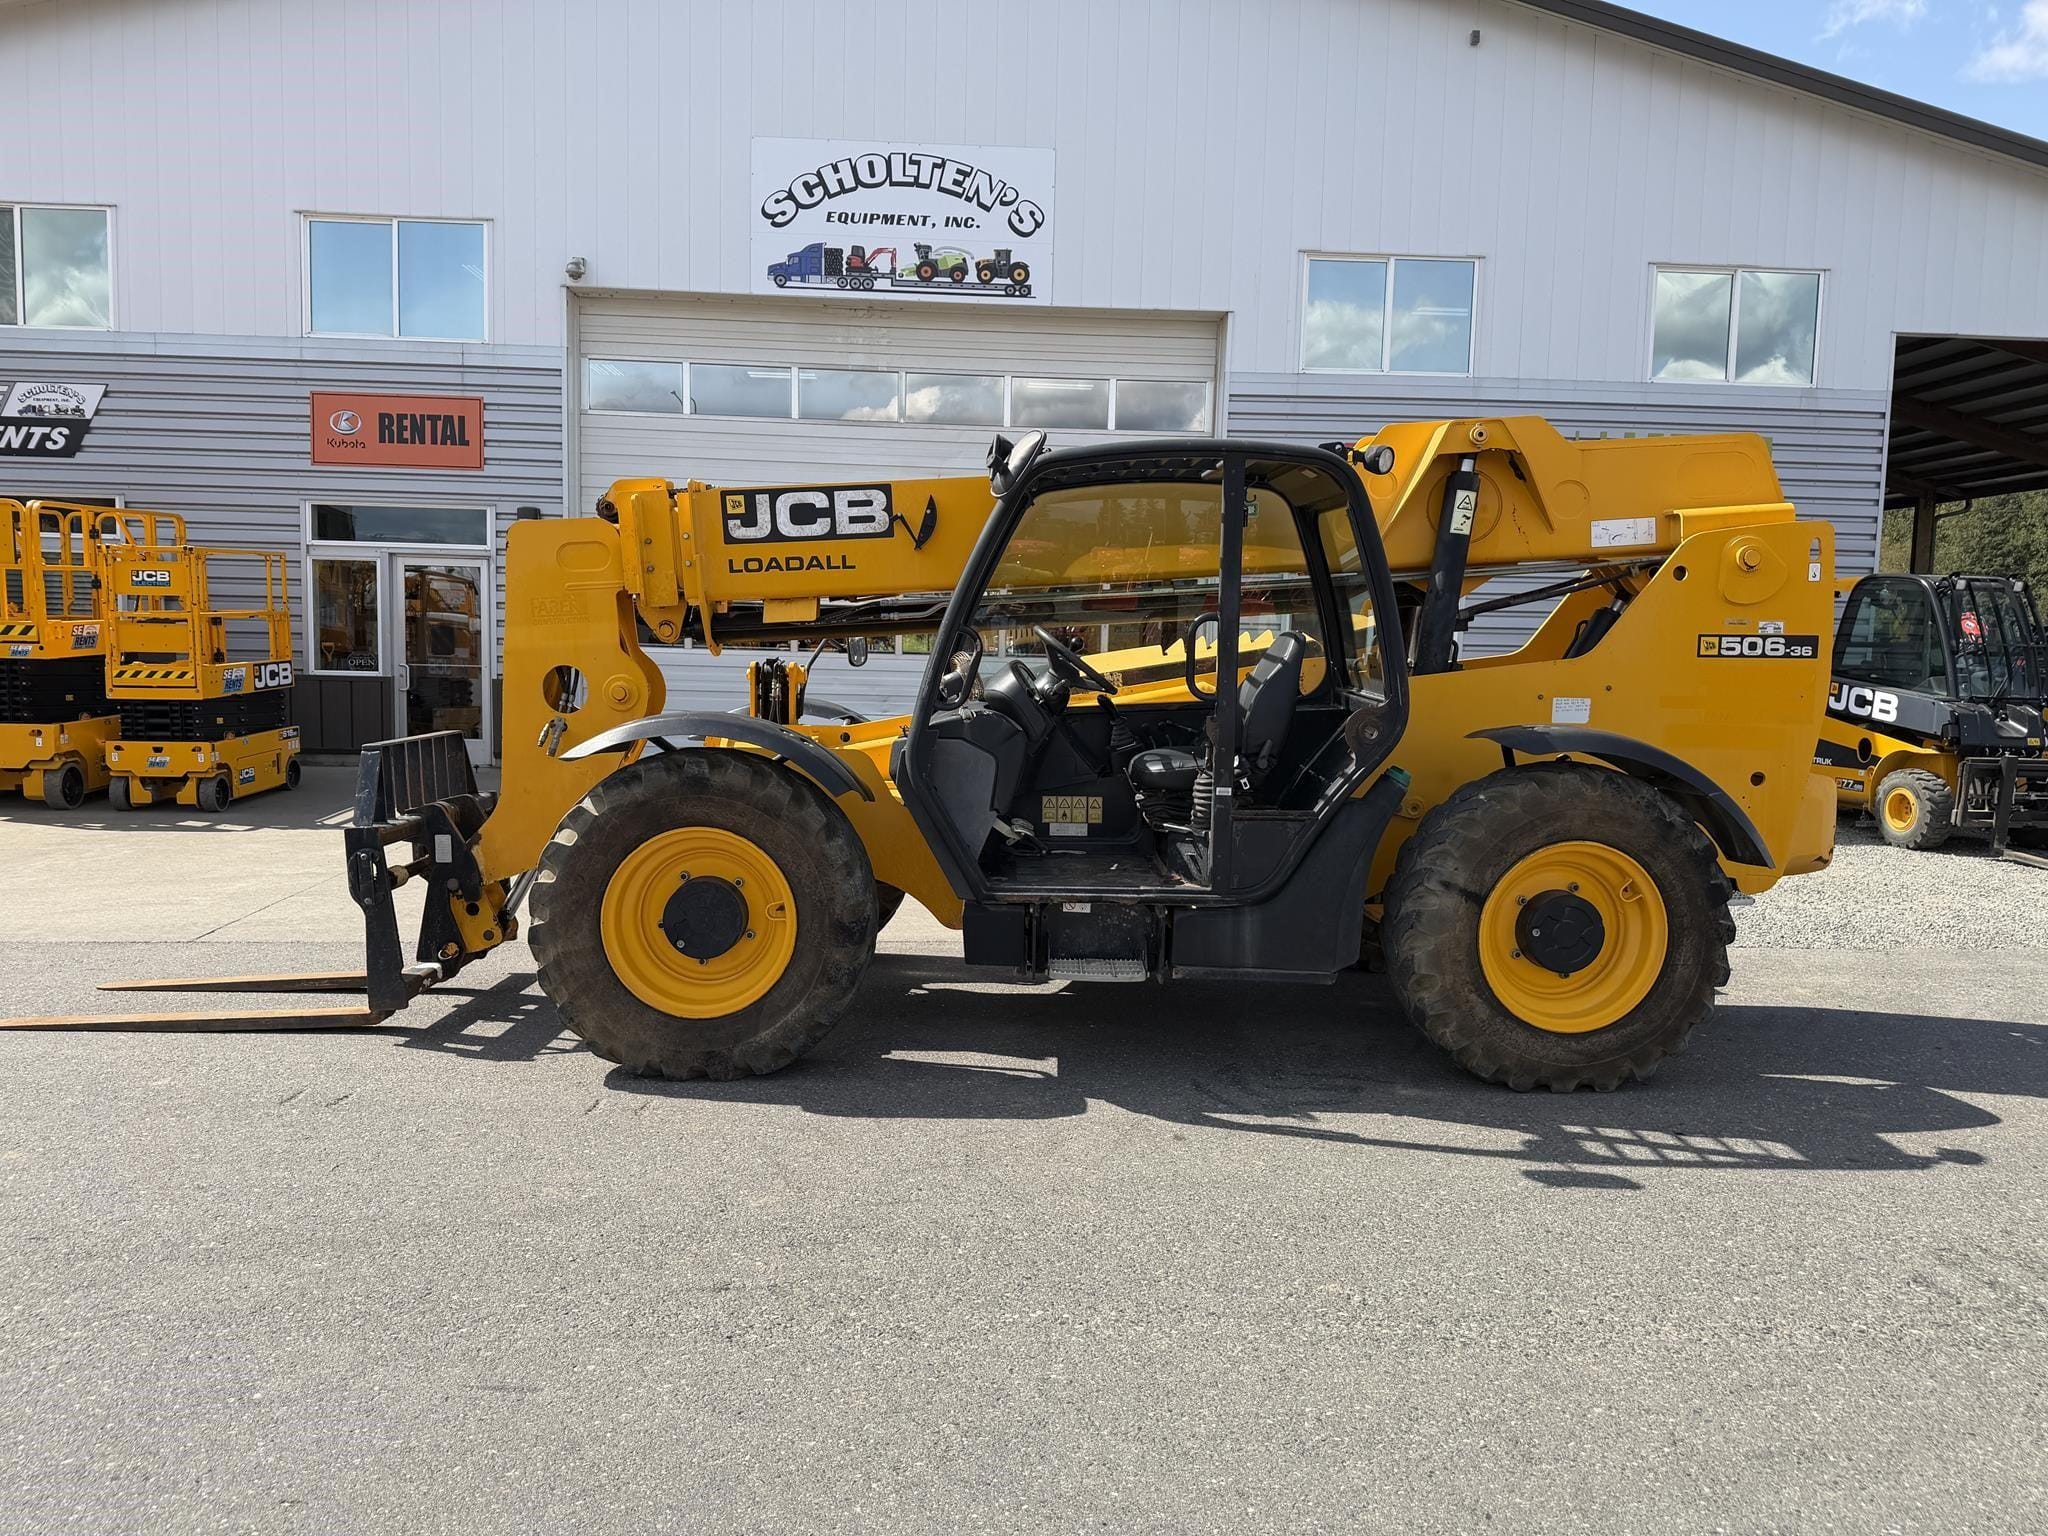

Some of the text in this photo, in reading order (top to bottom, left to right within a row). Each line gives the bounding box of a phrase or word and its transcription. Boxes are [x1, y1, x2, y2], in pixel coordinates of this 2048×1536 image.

[760, 152, 1045, 238] SCHOLTEN'S
[825, 211, 981, 229] EQUIPMENT, INC.
[0, 425, 70, 450] NTS
[378, 412, 470, 447] RENTAL
[327, 438, 366, 449] Kubota
[727, 489, 890, 539] JCB
[132, 570, 170, 581] JCB
[728, 555, 857, 574] LOADALL
[223, 669, 233, 679] SE
[255, 662, 293, 688] JCB
[1828, 684, 1899, 722] JCB
